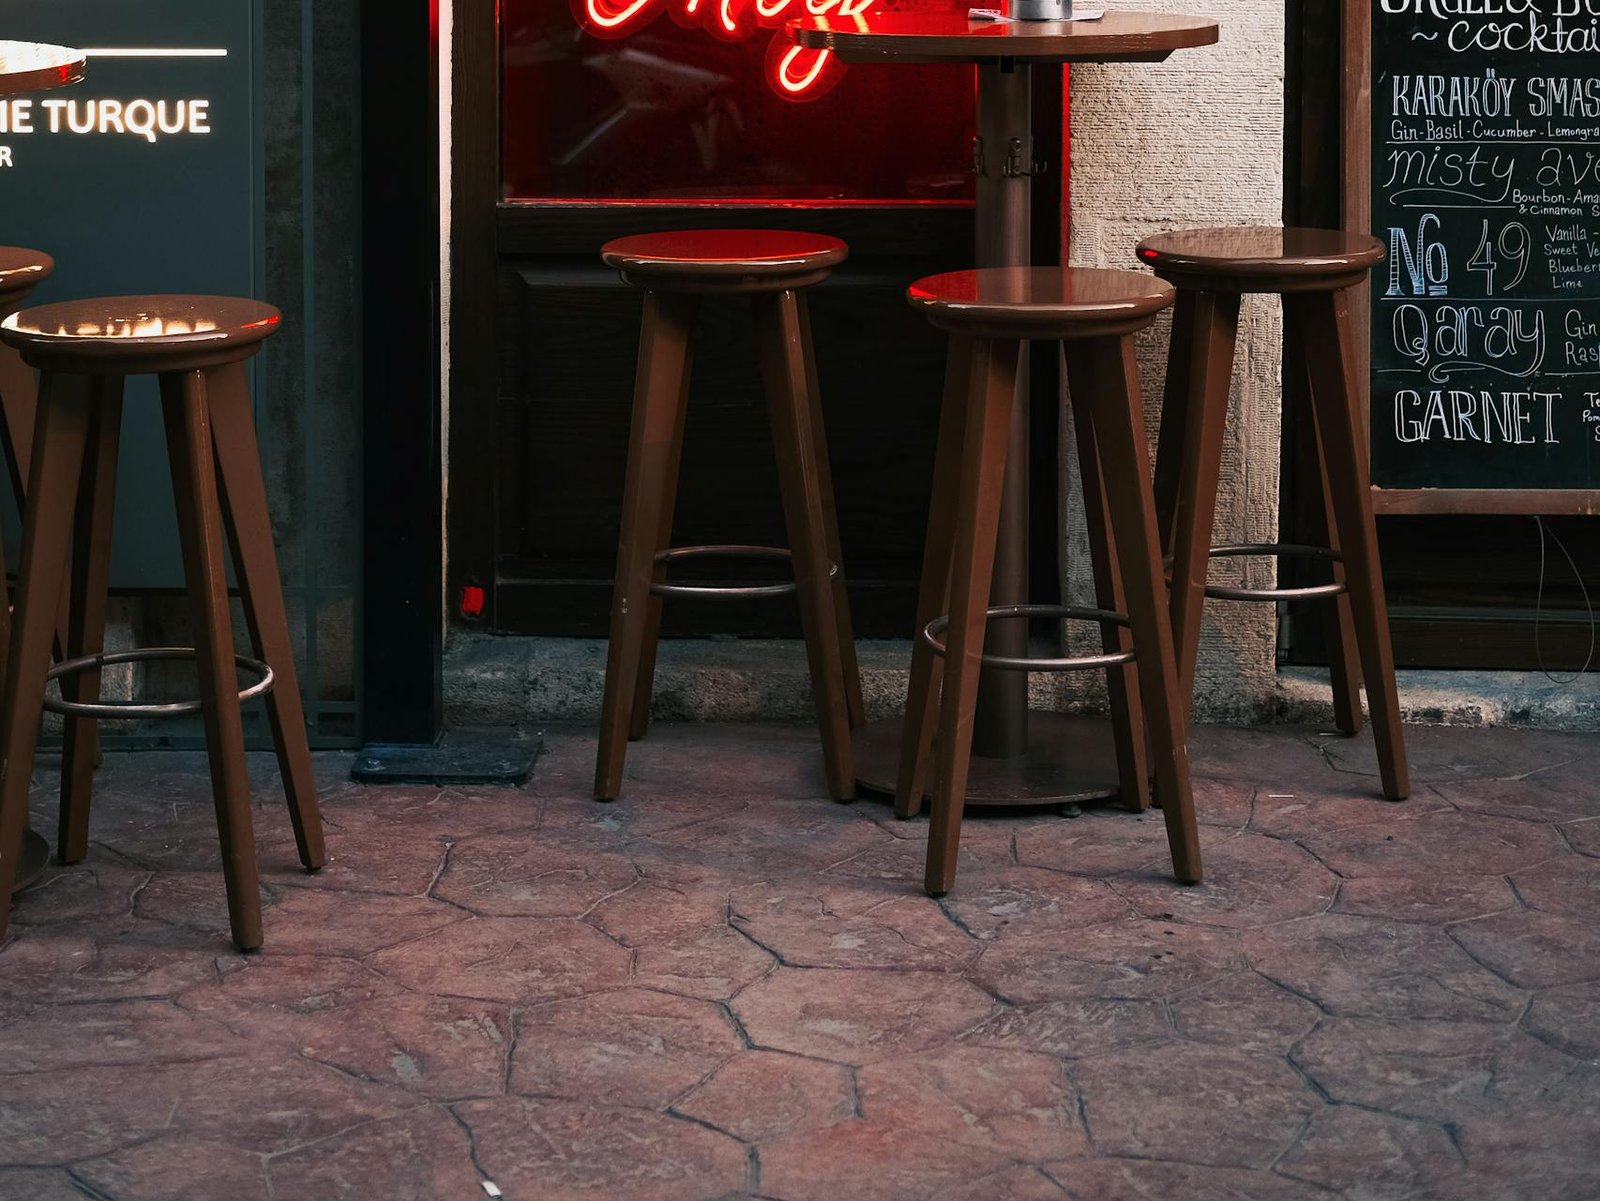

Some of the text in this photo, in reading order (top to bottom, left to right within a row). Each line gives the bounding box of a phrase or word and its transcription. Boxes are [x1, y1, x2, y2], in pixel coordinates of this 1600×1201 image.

[1392, 68, 1600, 117] KARAKÖY SMAS
[41, 99, 210, 142] TURQUE
[1382, 145, 1515, 205] misty
[1543, 242, 1579, 256] Sweet
[1545, 224, 1587, 242] Vanilla
[1466, 219, 1532, 296] 49
[1552, 276, 1583, 289] Lime
[1564, 308, 1598, 340] Gin
[1564, 340, 1600, 368] Ras
[1394, 389, 1562, 445] GARNET
